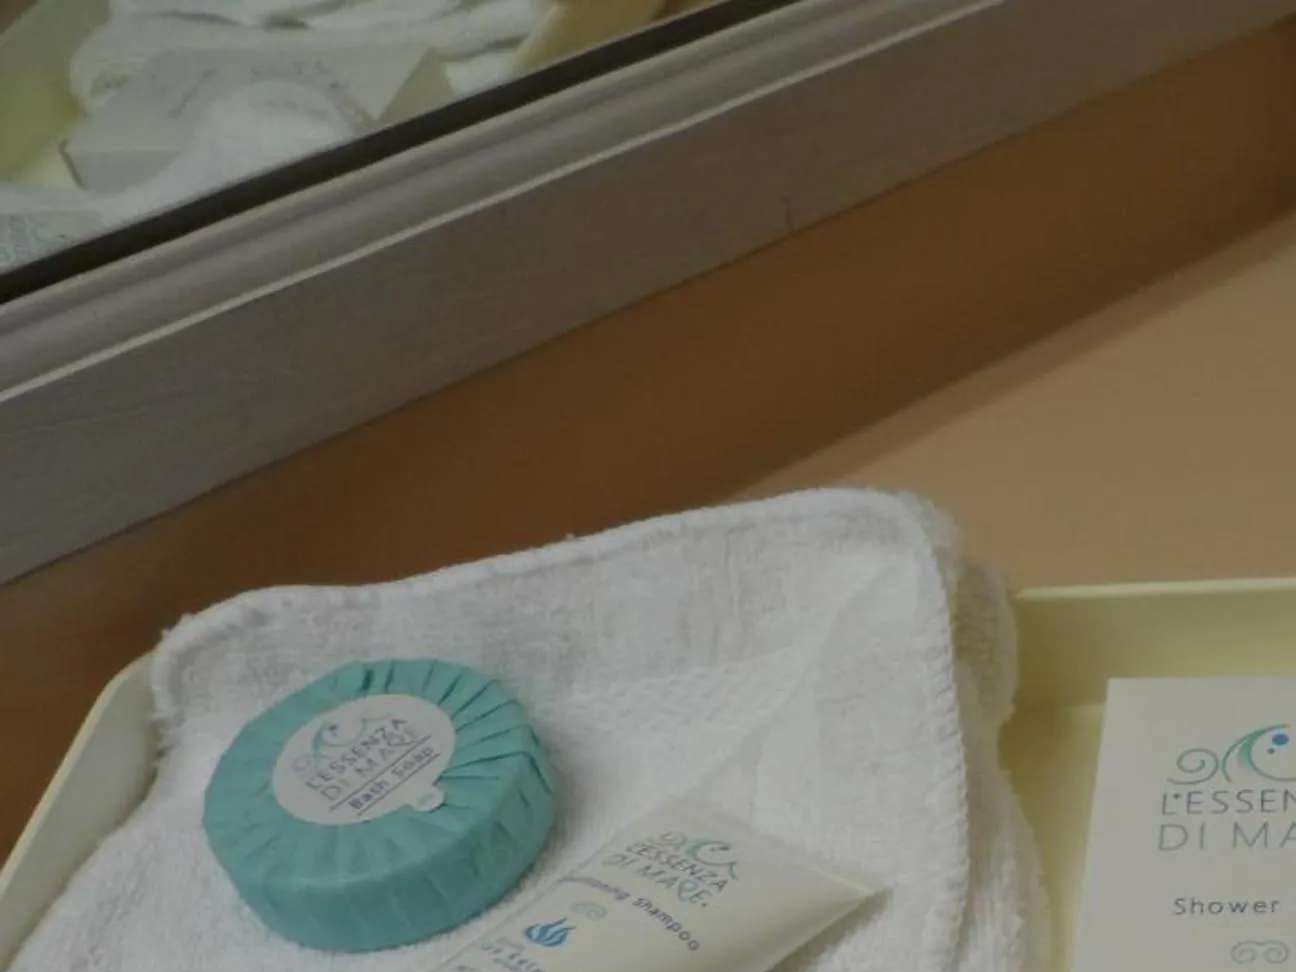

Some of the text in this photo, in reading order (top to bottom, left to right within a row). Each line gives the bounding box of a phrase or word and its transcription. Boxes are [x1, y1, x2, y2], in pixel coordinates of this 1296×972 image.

[321, 775, 353, 803] DI
[347, 744, 436, 812] Bath Soap
[1157, 822, 1206, 852] DI
[1172, 895, 1281, 917] Shower
[630, 894, 702, 953] Shampoo
